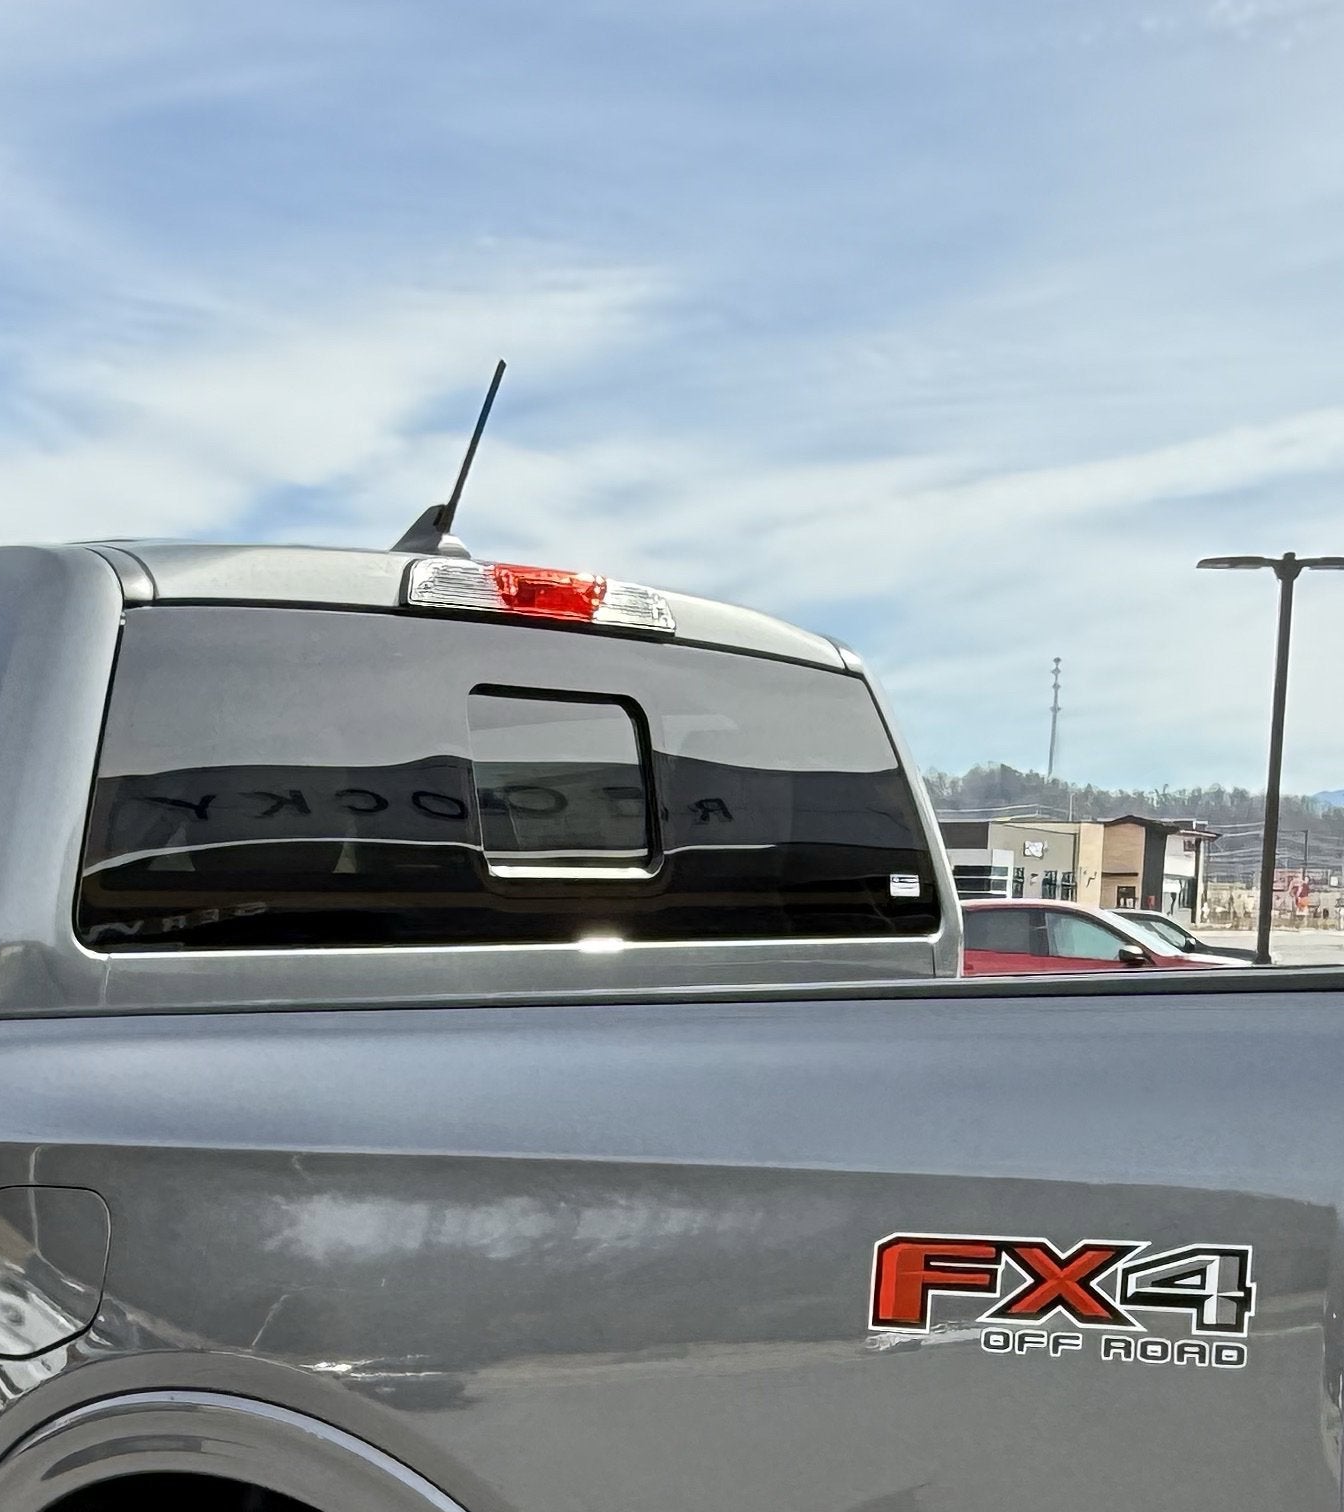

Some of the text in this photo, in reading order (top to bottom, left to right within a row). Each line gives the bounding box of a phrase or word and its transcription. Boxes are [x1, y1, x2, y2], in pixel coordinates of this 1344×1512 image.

[868, 1232, 1256, 1338] FX4
[981, 1327, 1247, 1368] OFF ROAD
